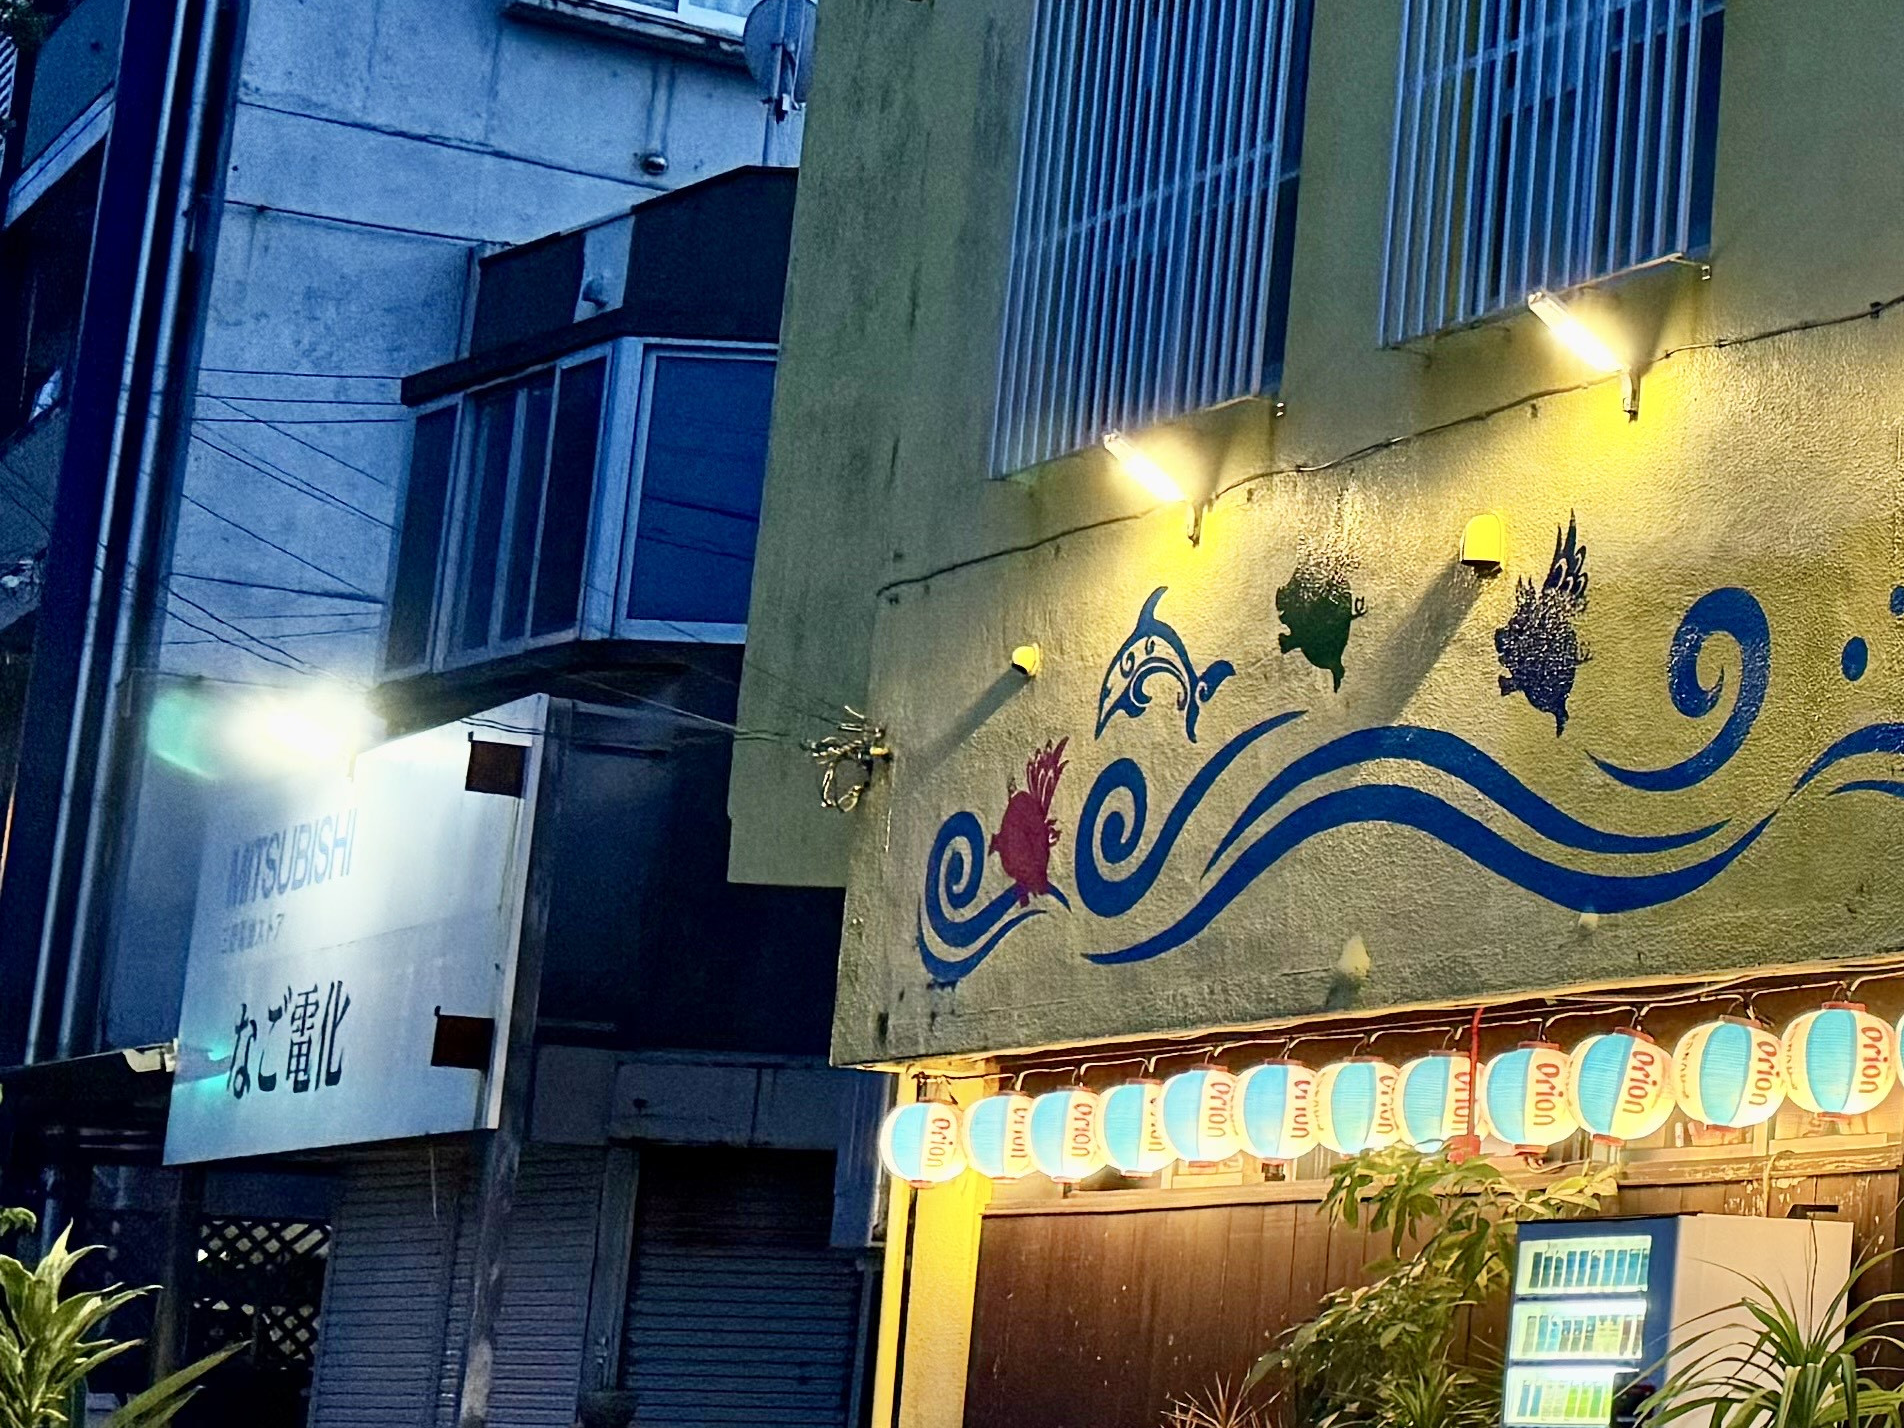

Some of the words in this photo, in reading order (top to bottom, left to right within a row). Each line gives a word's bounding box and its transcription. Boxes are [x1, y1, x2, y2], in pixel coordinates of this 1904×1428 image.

[226, 808, 357, 909] MITSUBISHI
[227, 980, 350, 1099] なご電化
